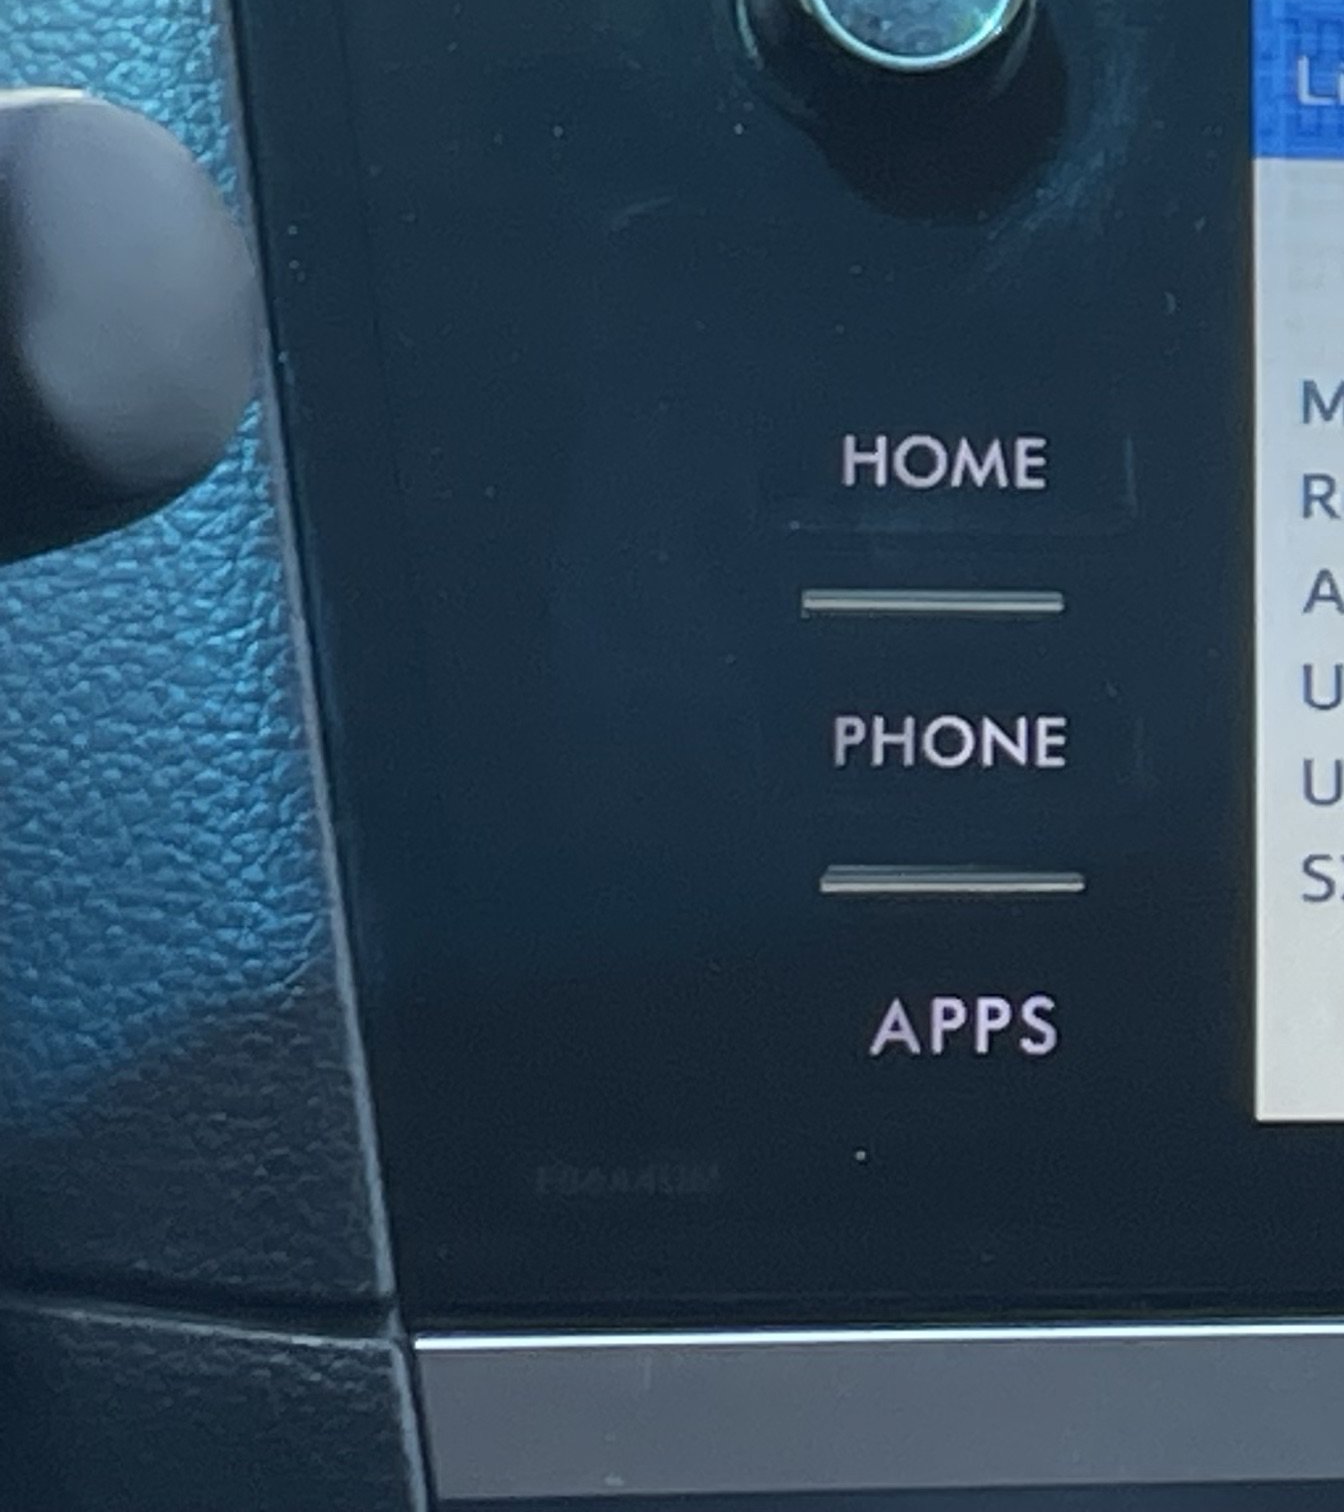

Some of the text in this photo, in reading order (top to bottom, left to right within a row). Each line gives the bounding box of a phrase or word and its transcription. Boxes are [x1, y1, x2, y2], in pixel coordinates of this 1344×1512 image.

[841, 434, 1047, 491] HOME
[832, 715, 1067, 769] PHONE
[869, 996, 1060, 1056] APPS
